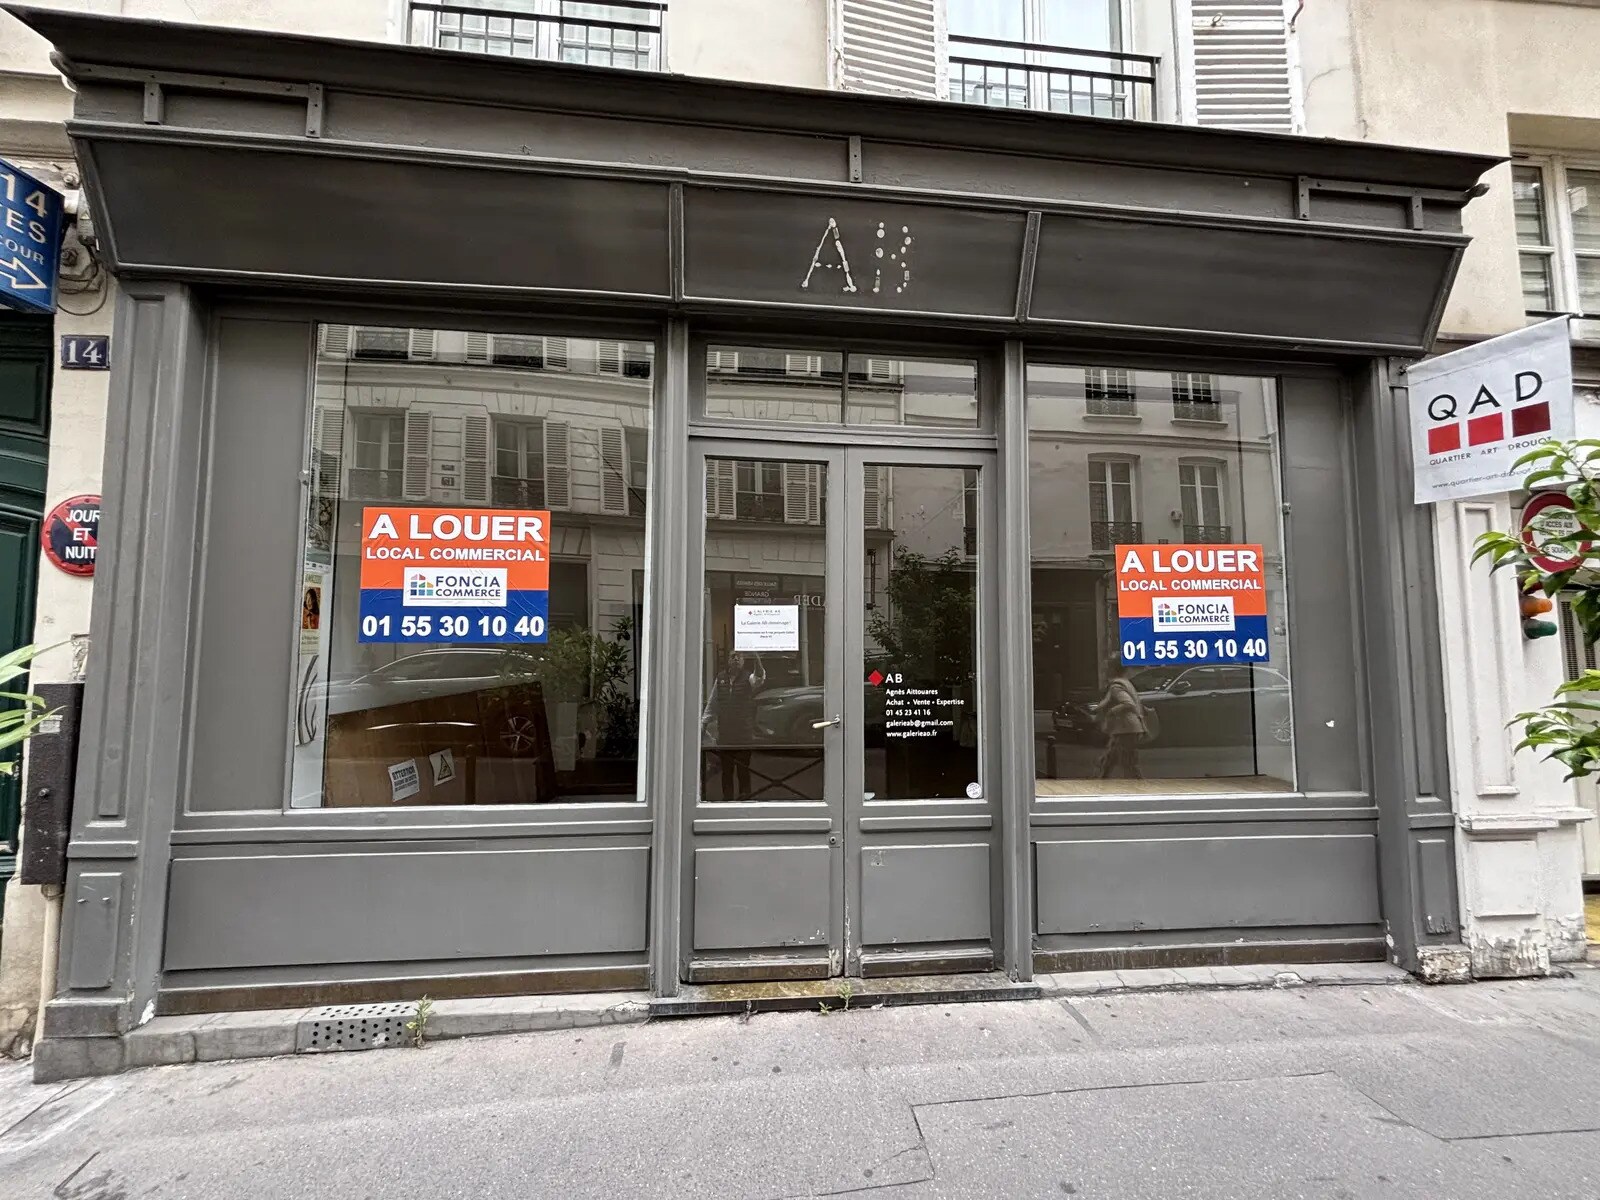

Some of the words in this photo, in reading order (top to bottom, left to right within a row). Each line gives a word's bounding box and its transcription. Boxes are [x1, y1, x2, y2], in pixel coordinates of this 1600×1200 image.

[0, 206, 46, 244] ES
[67, 340, 102, 363] 14
[1429, 452, 1471, 466] QUARTIER
[1480, 446, 1498, 455] ART
[1432, 464, 1552, 489] www.quartier-art-drouot
[65, 509, 101, 523] JOUR
[73, 527, 92, 541] ET
[368, 514, 399, 540] A
[409, 514, 545, 542] LOUER
[65, 546, 97, 559] NUIT
[366, 547, 425, 560] LOCAL
[430, 547, 545, 562] COMMERCIAL
[1121, 550, 1146, 573] A
[1152, 550, 1259, 573] LOUER
[436, 576, 500, 588] FONCIA
[1120, 580, 1167, 591] LOCAL
[1171, 579, 1261, 591] COMMERCIAL
[435, 589, 500, 597] COMMERCE
[1178, 604, 1229, 615] FONCIA
[362, 615, 390, 637] 01
[401, 615, 432, 637] 55
[439, 615, 469, 637] 30
[478, 615, 507, 637] 10
[514, 615, 545, 637] 40
[1178, 615, 1230, 624] COMMERCE
[1123, 640, 1146, 660] 01
[1154, 640, 1178, 659] 55
[1184, 639, 1208, 658] 30
[1214, 639, 1237, 658] 10
[1243, 638, 1267, 657] 40
[885, 673, 903, 684] AB
[885, 688, 905, 697] Agnès
[936, 698, 965, 706] Expertise
[886, 719, 954, 728] galerieab@gmail.com
